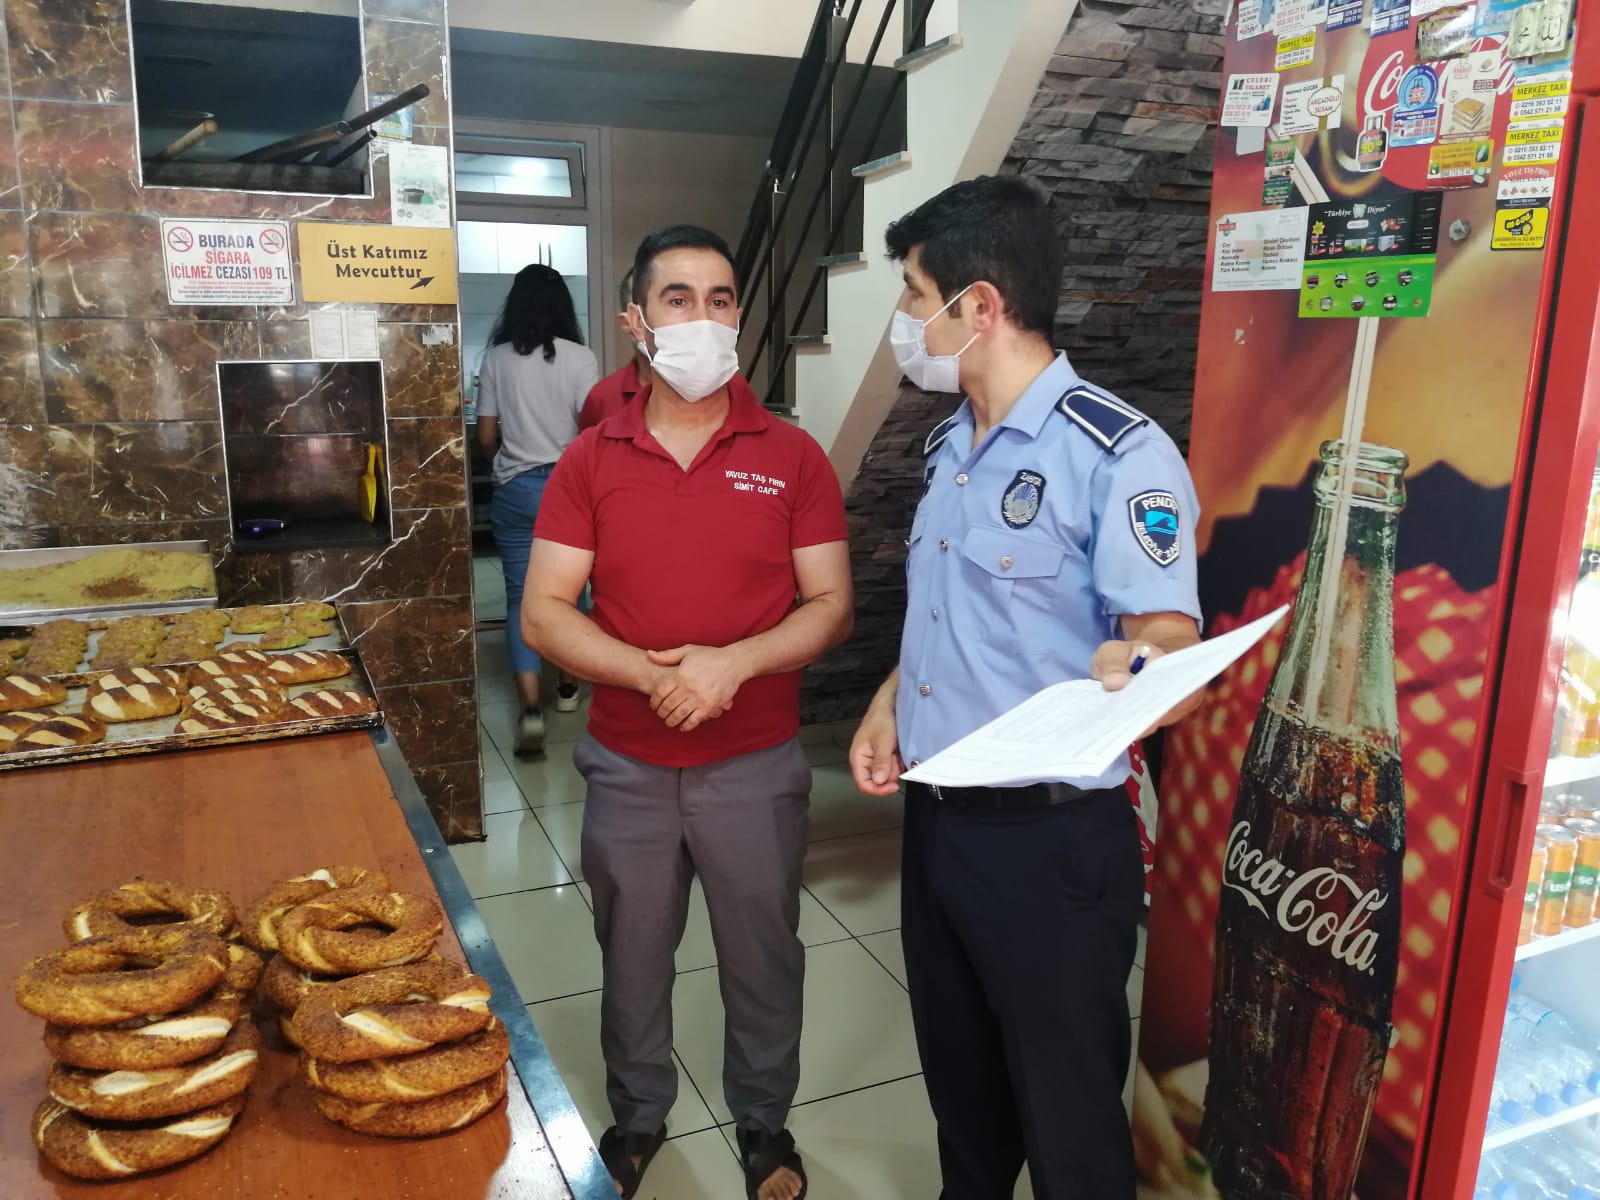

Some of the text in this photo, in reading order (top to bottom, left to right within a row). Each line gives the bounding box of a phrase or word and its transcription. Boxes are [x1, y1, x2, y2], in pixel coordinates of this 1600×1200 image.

[1516, 86, 1547, 95] MERKEZ
[1509, 131, 1540, 140] MERKEZ
[198, 234, 255, 249] BURADA
[205, 248, 251, 265] SİGARA
[327, 240, 428, 260] Üst Katımız
[170, 262, 288, 280] İÇİLMEZ CEZASI 109 TL
[336, 264, 422, 278] Mevcuttur
[725, 470, 748, 480] YAVUZ
[751, 474, 766, 484] TAŞ
[734, 481, 778, 495] SİMİT CAFE
